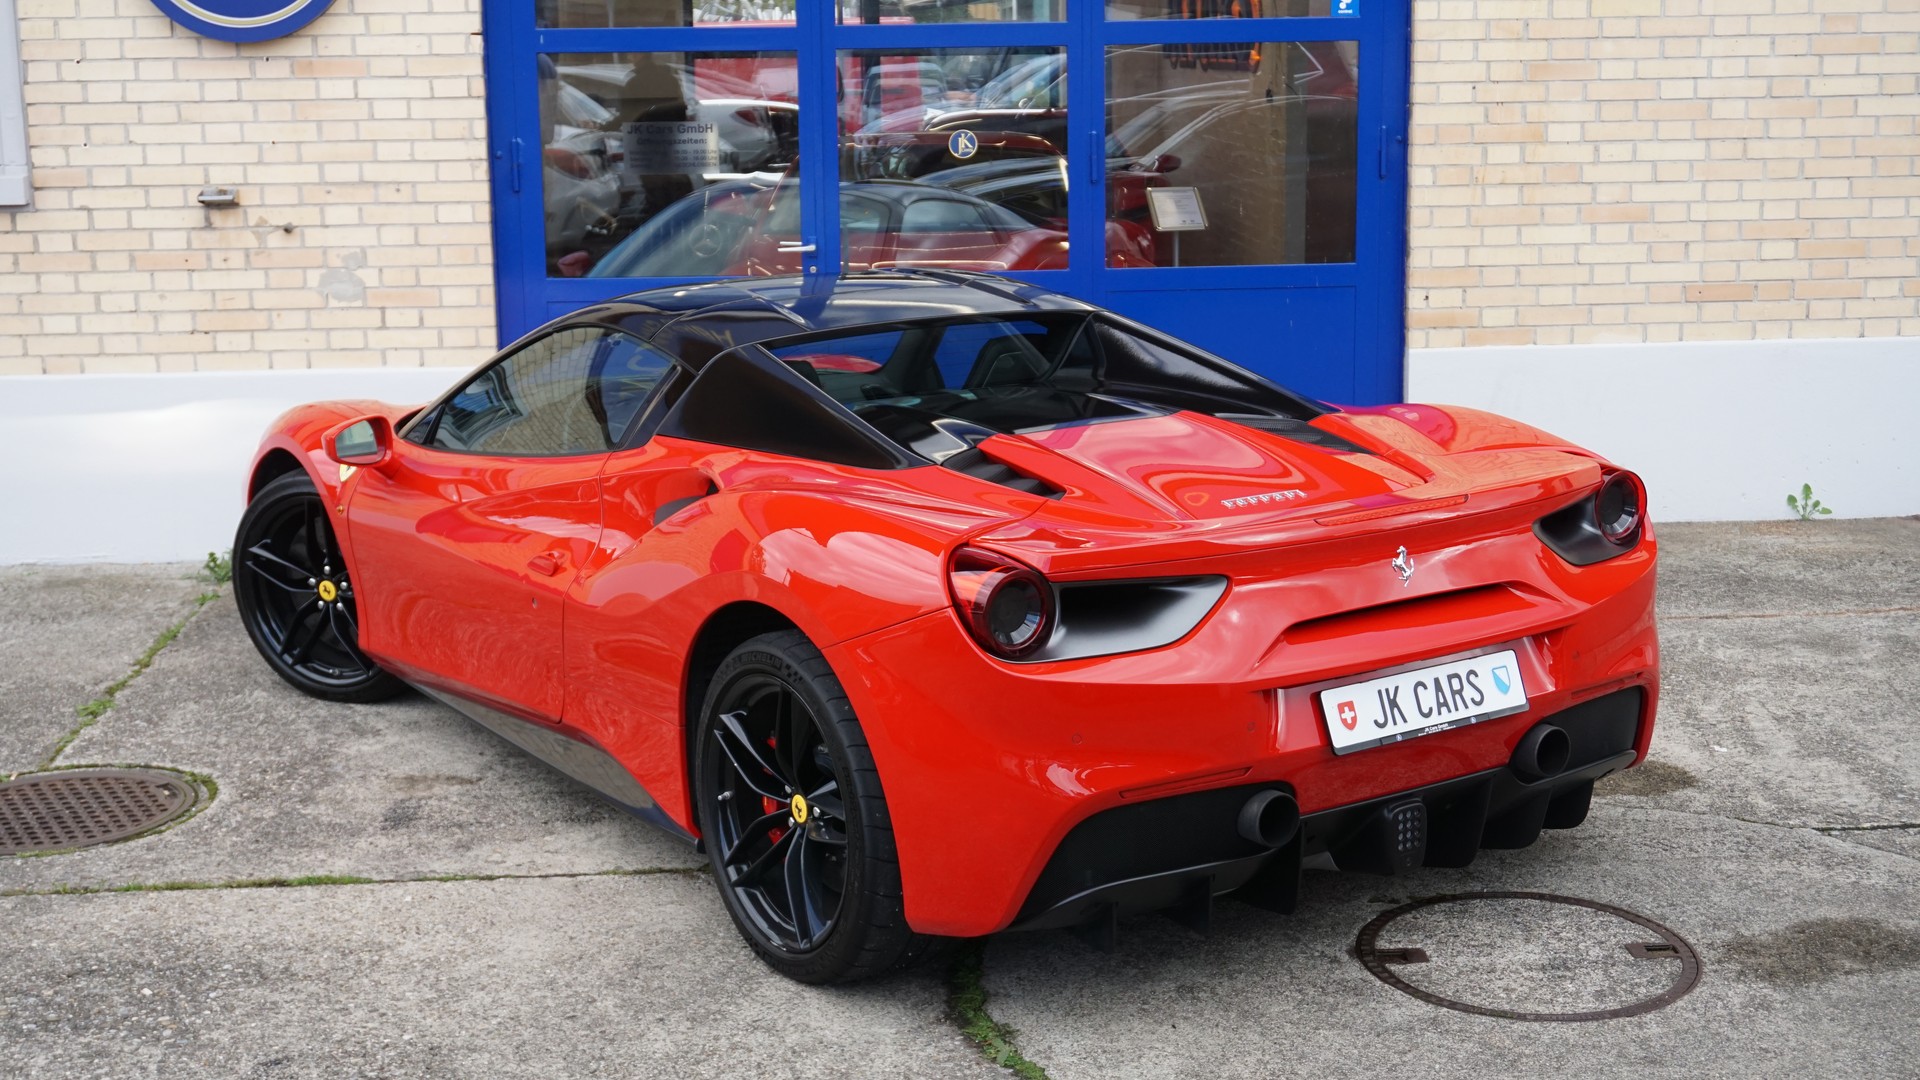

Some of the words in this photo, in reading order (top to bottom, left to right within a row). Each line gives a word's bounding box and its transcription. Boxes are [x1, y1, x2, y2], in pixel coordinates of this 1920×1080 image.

[627, 125, 642, 134] JK
[646, 124, 673, 134] Cars
[677, 123, 713, 134] GmbH
[1221, 489, 1308, 509] Ferrari
[1373, 685, 1408, 729] JK
[1413, 669, 1485, 719] CARS
